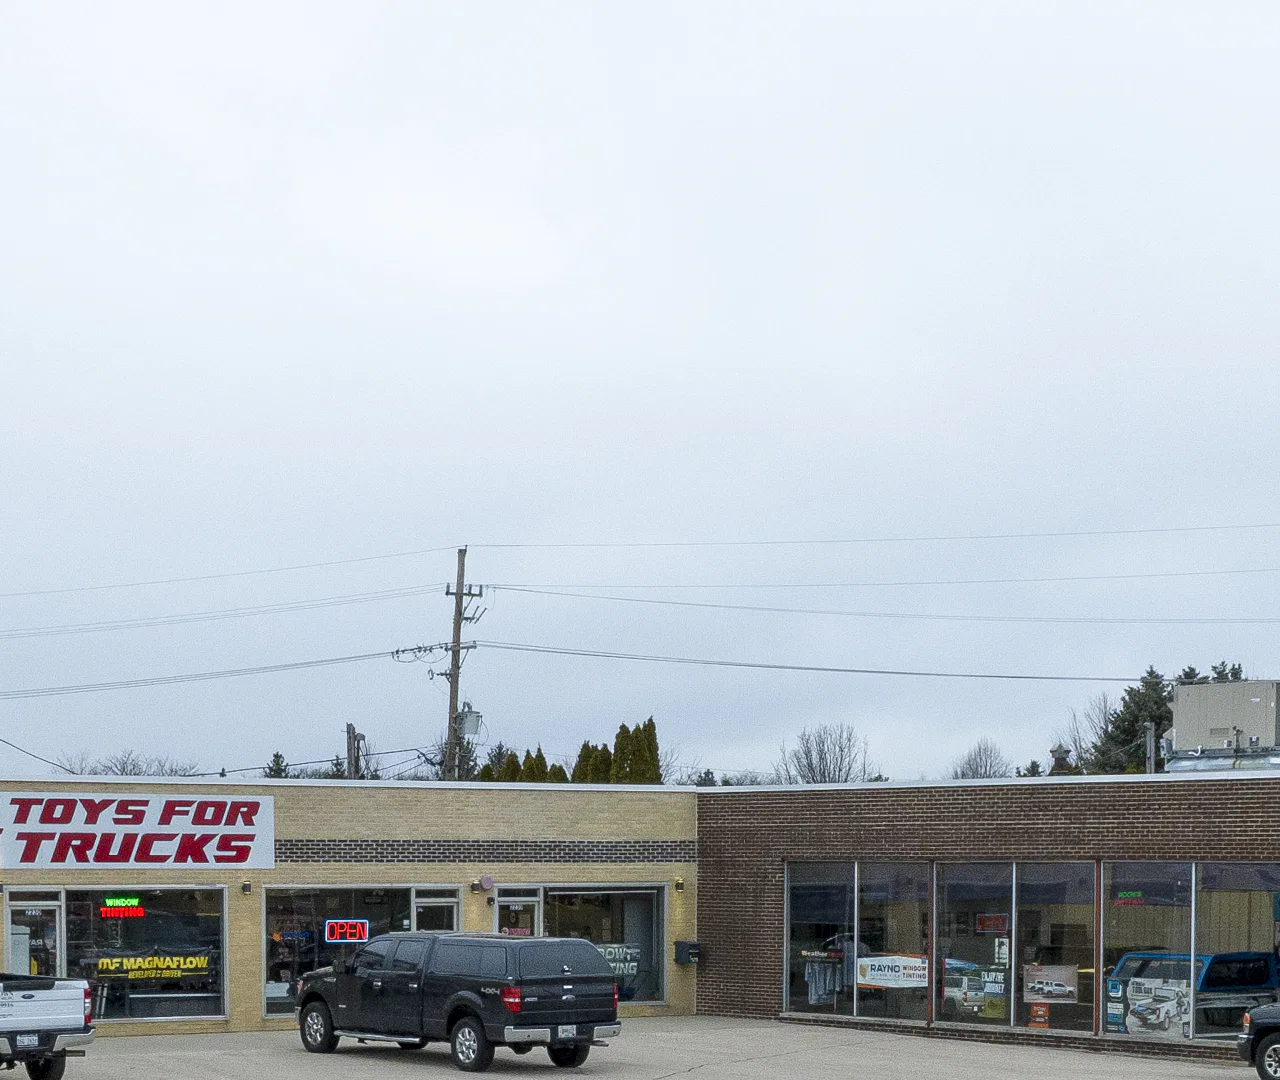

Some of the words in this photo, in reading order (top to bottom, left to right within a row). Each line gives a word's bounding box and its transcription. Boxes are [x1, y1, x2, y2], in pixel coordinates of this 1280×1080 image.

[10, 798, 150, 825] TOYS
[158, 800, 260, 827] FOR
[15, 832, 256, 864] TRUCKS
[105, 898, 139, 907] WINDOW
[100, 907, 145, 918] TINTING
[327, 921, 367, 940] OPEN
[123, 956, 209, 970] MAGNAFLOW
[870, 964, 900, 973] RAYNO
[902, 972, 927, 980] TINTING
